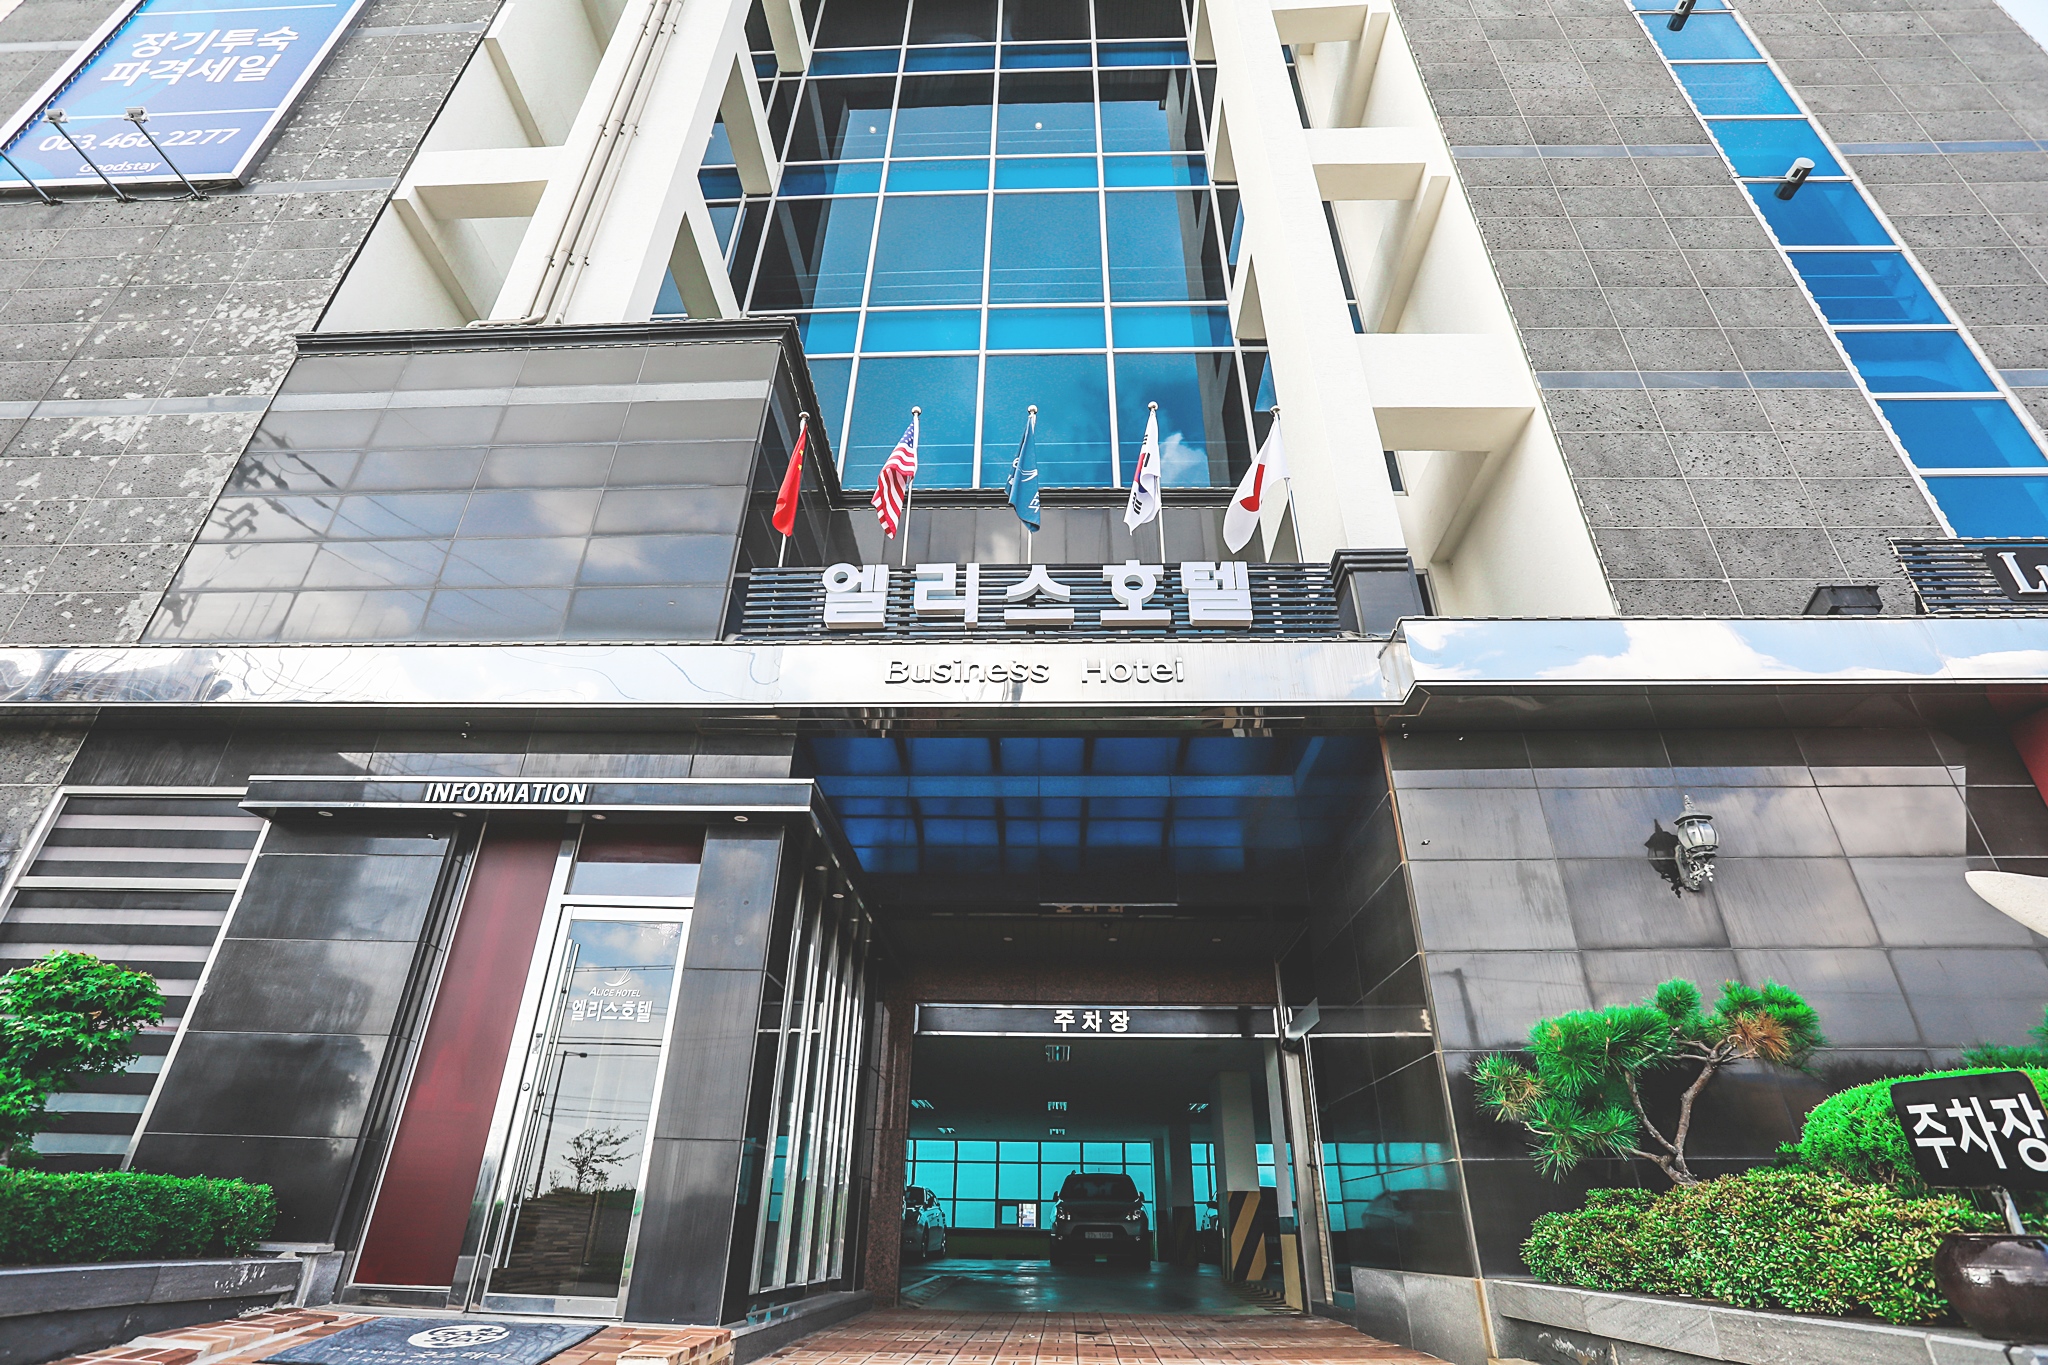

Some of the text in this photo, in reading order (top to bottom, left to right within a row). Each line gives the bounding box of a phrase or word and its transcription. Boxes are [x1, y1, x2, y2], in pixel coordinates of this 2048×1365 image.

[131, 26, 299, 58] 장기투숙
[100, 53, 282, 87] 파격세일
[38, 127, 241, 151] 063.4662277
[79, 160, 162, 173] Goodstay
[822, 560, 1254, 630] 엘리스호텔
[884, 656, 1185, 684] Business Hotel
[424, 782, 588, 804] INFORMATION
[615, 988, 641, 998] HOTEL
[571, 998, 653, 1023] 엘리스호텔
[1053, 1009, 1131, 1033] 주차장
[1906, 1093, 2048, 1172] 주차장
